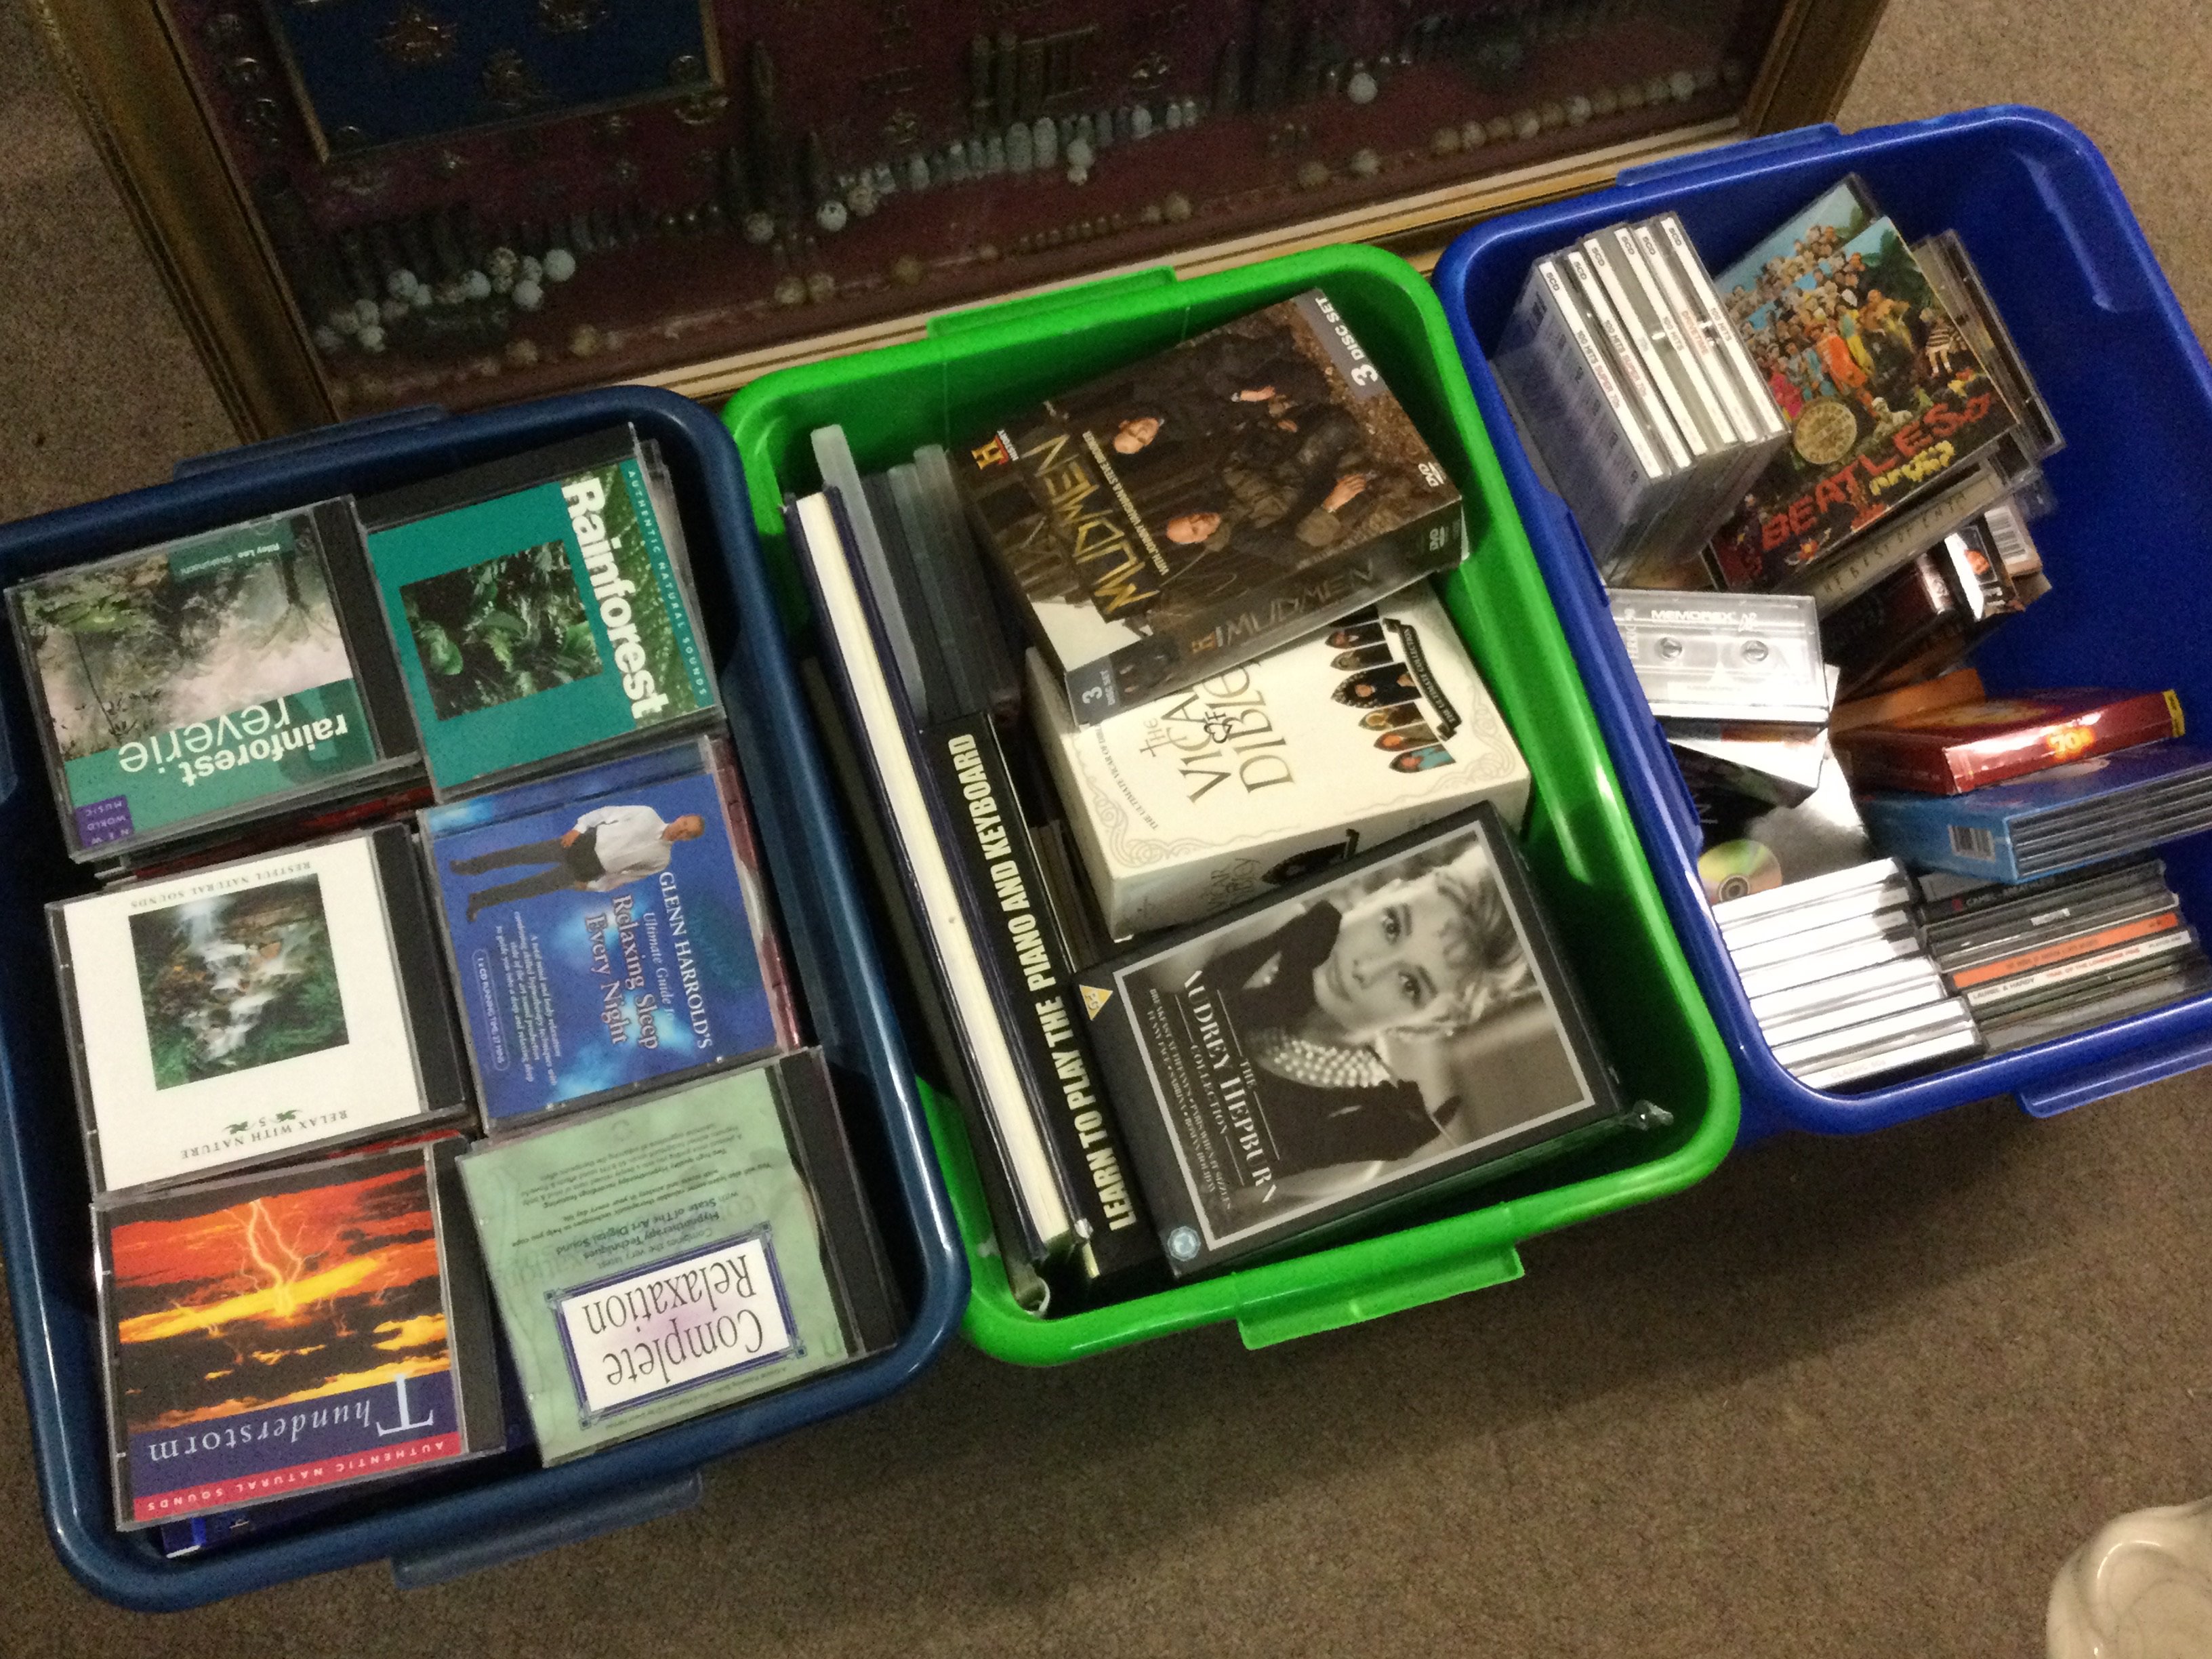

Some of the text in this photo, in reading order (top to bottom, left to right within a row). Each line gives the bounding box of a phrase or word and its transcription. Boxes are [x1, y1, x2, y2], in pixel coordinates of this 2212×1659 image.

[1545, 270, 1561, 291] 5CD
[1573, 260, 1588, 281] 5CD
[1317, 294, 1379, 388] 3 DISC SET
[996, 427, 1019, 461] HISTORY
[1099, 461, 1119, 485] STEVE
[1015, 430, 1159, 615] MUDMEN
[1114, 488, 1142, 525] VAUGHAN
[236, 540, 281, 561] Riley Lee
[1134, 523, 1159, 555] JOHNNY
[1150, 552, 1170, 575] WITH
[560, 476, 671, 719] Rainforest
[627, 470, 708, 697] AUTHENTIC NATURAL SOUNDS
[1080, 686, 1103, 704] 3
[115, 695, 294, 783] reverie
[176, 712, 350, 789] rainforest
[1100, 744, 1158, 830] THE ULTIMATE VICAR OF
[129, 860, 311, 910] RESTFUL NATURAL SOUNDS
[578, 913, 635, 1046] Every Night
[605, 893, 667, 1052] Relaxing Sleep
[640, 910, 667, 964] Ultimate
[654, 966, 675, 1005] Guide
[657, 870, 713, 1050] GLENN HARROLD'S
[945, 731, 1137, 1230] LEARN TO PLAY THE PIANO AND KEYBOARD
[1181, 970, 1280, 1204] AUDREY HEPBURN
[1189, 1044, 1229, 1134] COLLECTION
[1239, 1059, 1257, 1089] THE
[179, 1109, 348, 1159] RELAX WITH NATURE
[630, 1218, 651, 1232] Art
[672, 1207, 686, 1219] of
[686, 1197, 716, 1214] State
[554, 1237, 590, 1256] Sound
[581, 1209, 720, 1261] Hypnotherapy Techniques
[592, 1223, 629, 1244] Digital
[647, 1242, 664, 1254] the
[665, 1227, 712, 1249] Combines
[596, 1254, 623, 1270] latest
[580, 1253, 758, 1349] Relaxation
[599, 1306, 766, 1388] Complete
[146, 1368, 435, 1471] Thunderstorm
[145, 1440, 445, 1511] AUTHENTIC NATURAL SOUNDS
